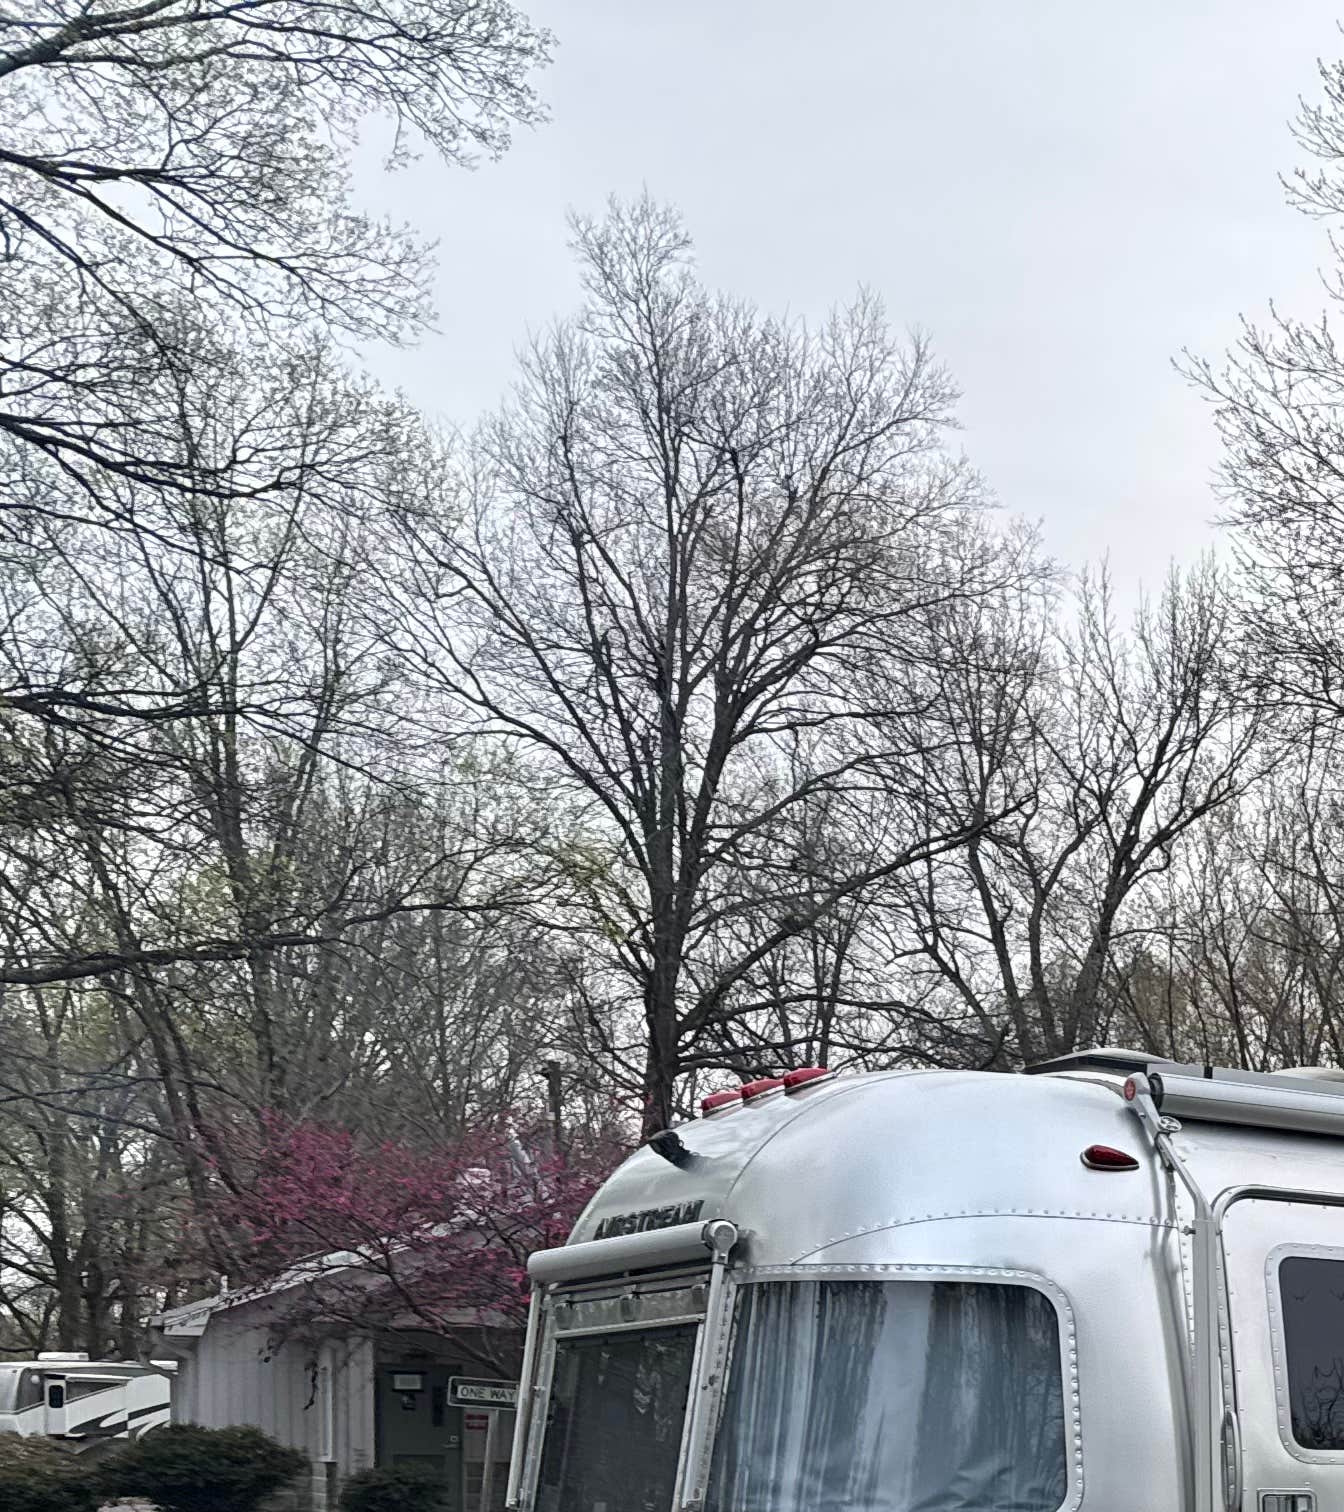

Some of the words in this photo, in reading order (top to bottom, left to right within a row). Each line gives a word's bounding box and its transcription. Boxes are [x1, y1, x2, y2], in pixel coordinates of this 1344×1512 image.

[593, 1199, 705, 1240] AIRSTREAM
[460, 1386, 487, 1399] ONE
[490, 1388, 517, 1401] WAY
